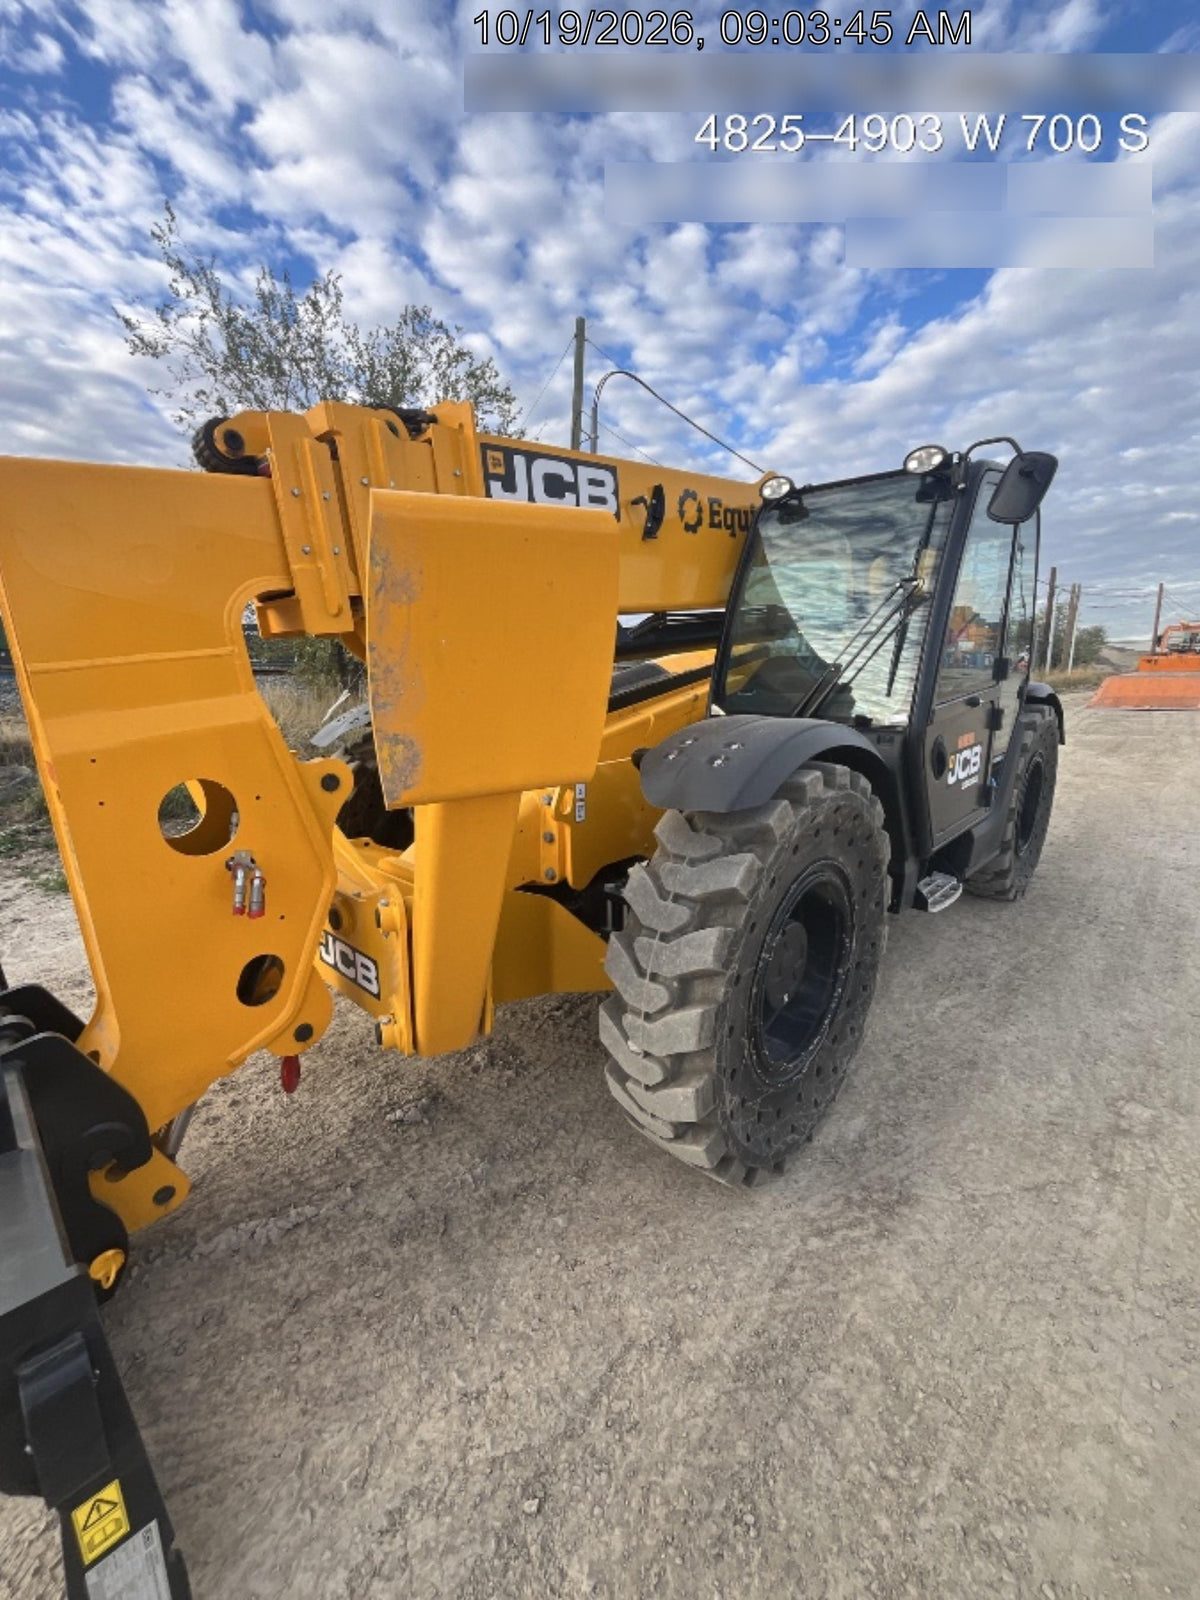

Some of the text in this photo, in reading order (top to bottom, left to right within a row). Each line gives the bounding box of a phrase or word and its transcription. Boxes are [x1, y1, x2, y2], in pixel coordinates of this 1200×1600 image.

[490, 454, 617, 512] JCB
[947, 744, 982, 785] JCB
[319, 934, 379, 995] JCB
